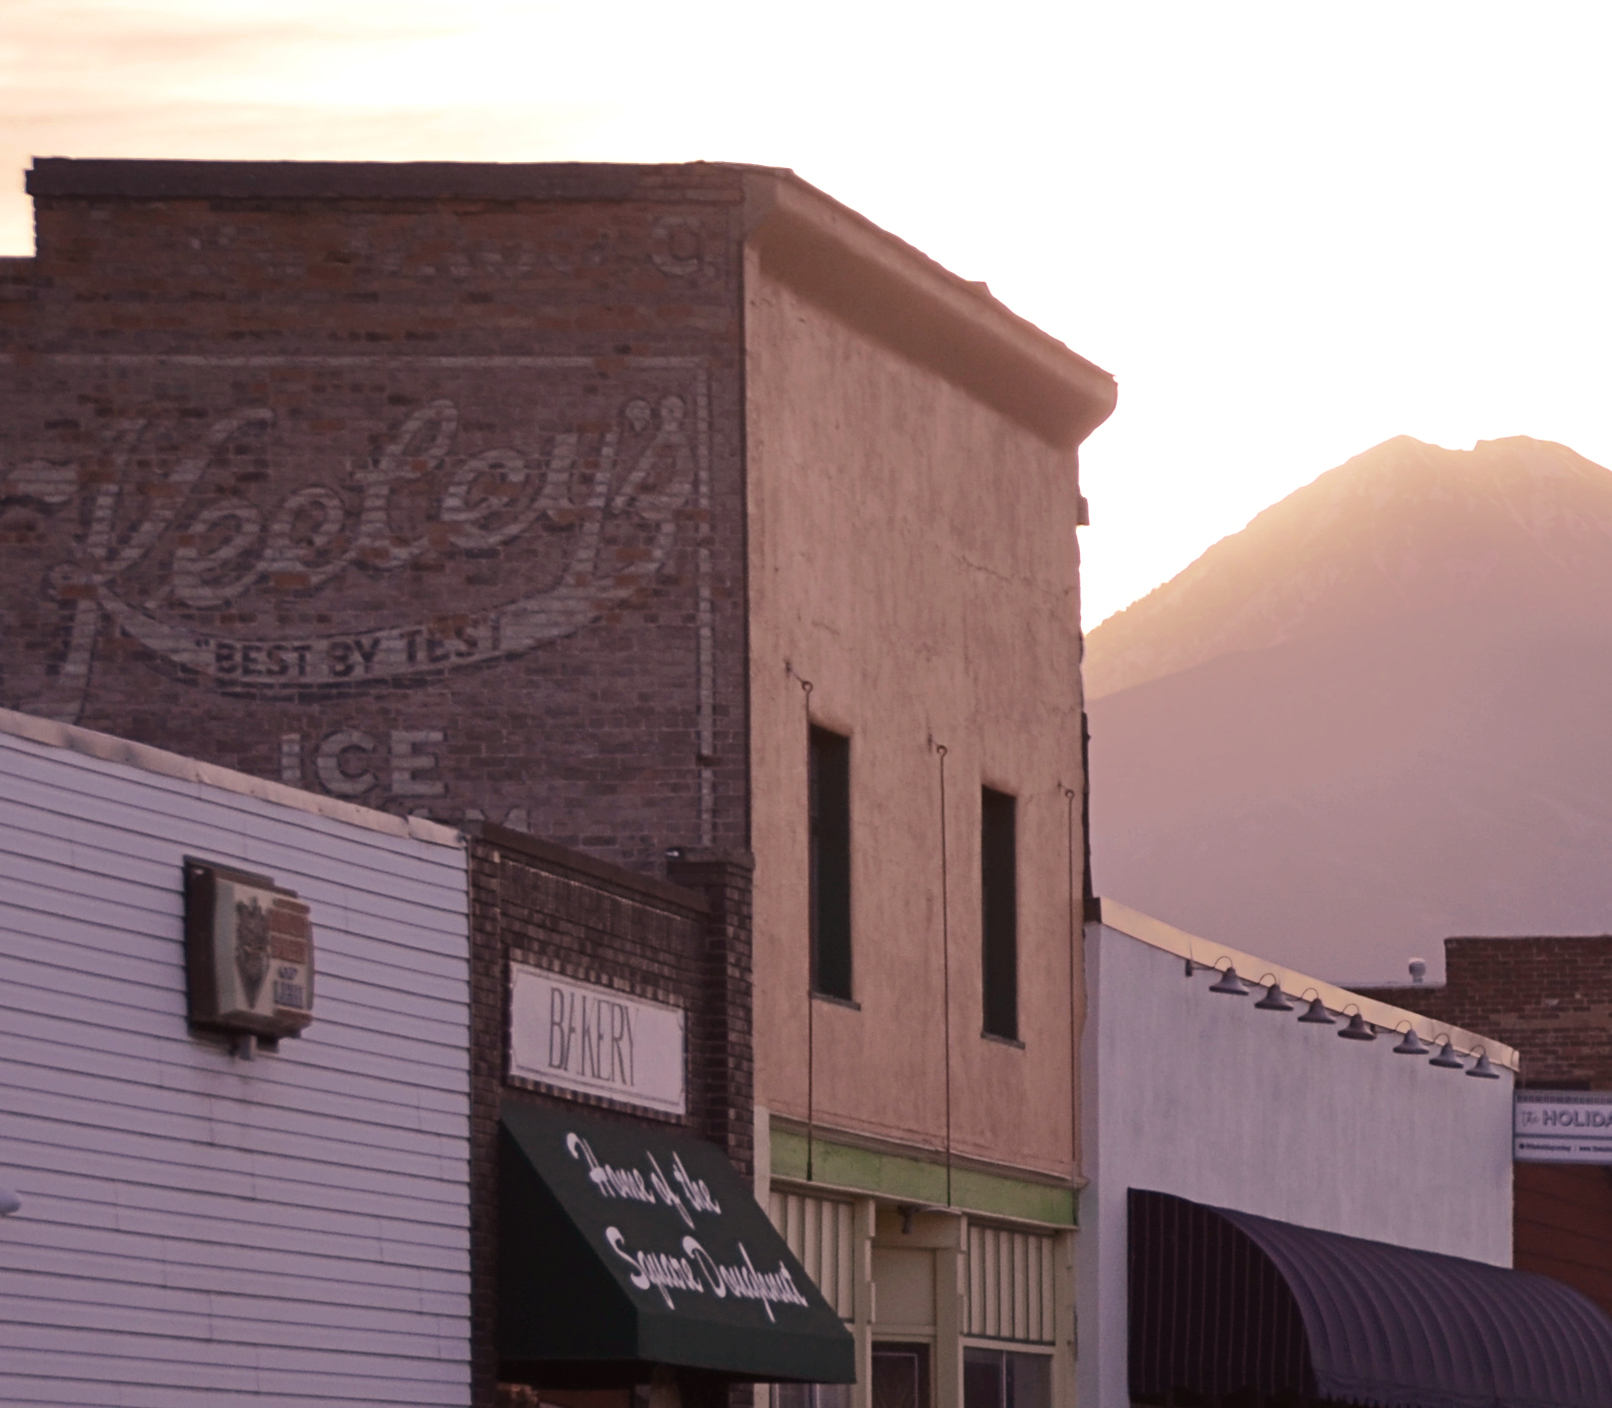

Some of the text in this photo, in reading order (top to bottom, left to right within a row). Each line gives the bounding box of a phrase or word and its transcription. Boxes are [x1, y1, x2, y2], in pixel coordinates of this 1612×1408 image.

[280, 729, 448, 796] ICE
[548, 986, 639, 1087] BAKERY
[566, 1133, 721, 1230] Home of the
[606, 1226, 809, 1323] Square Doughnut
